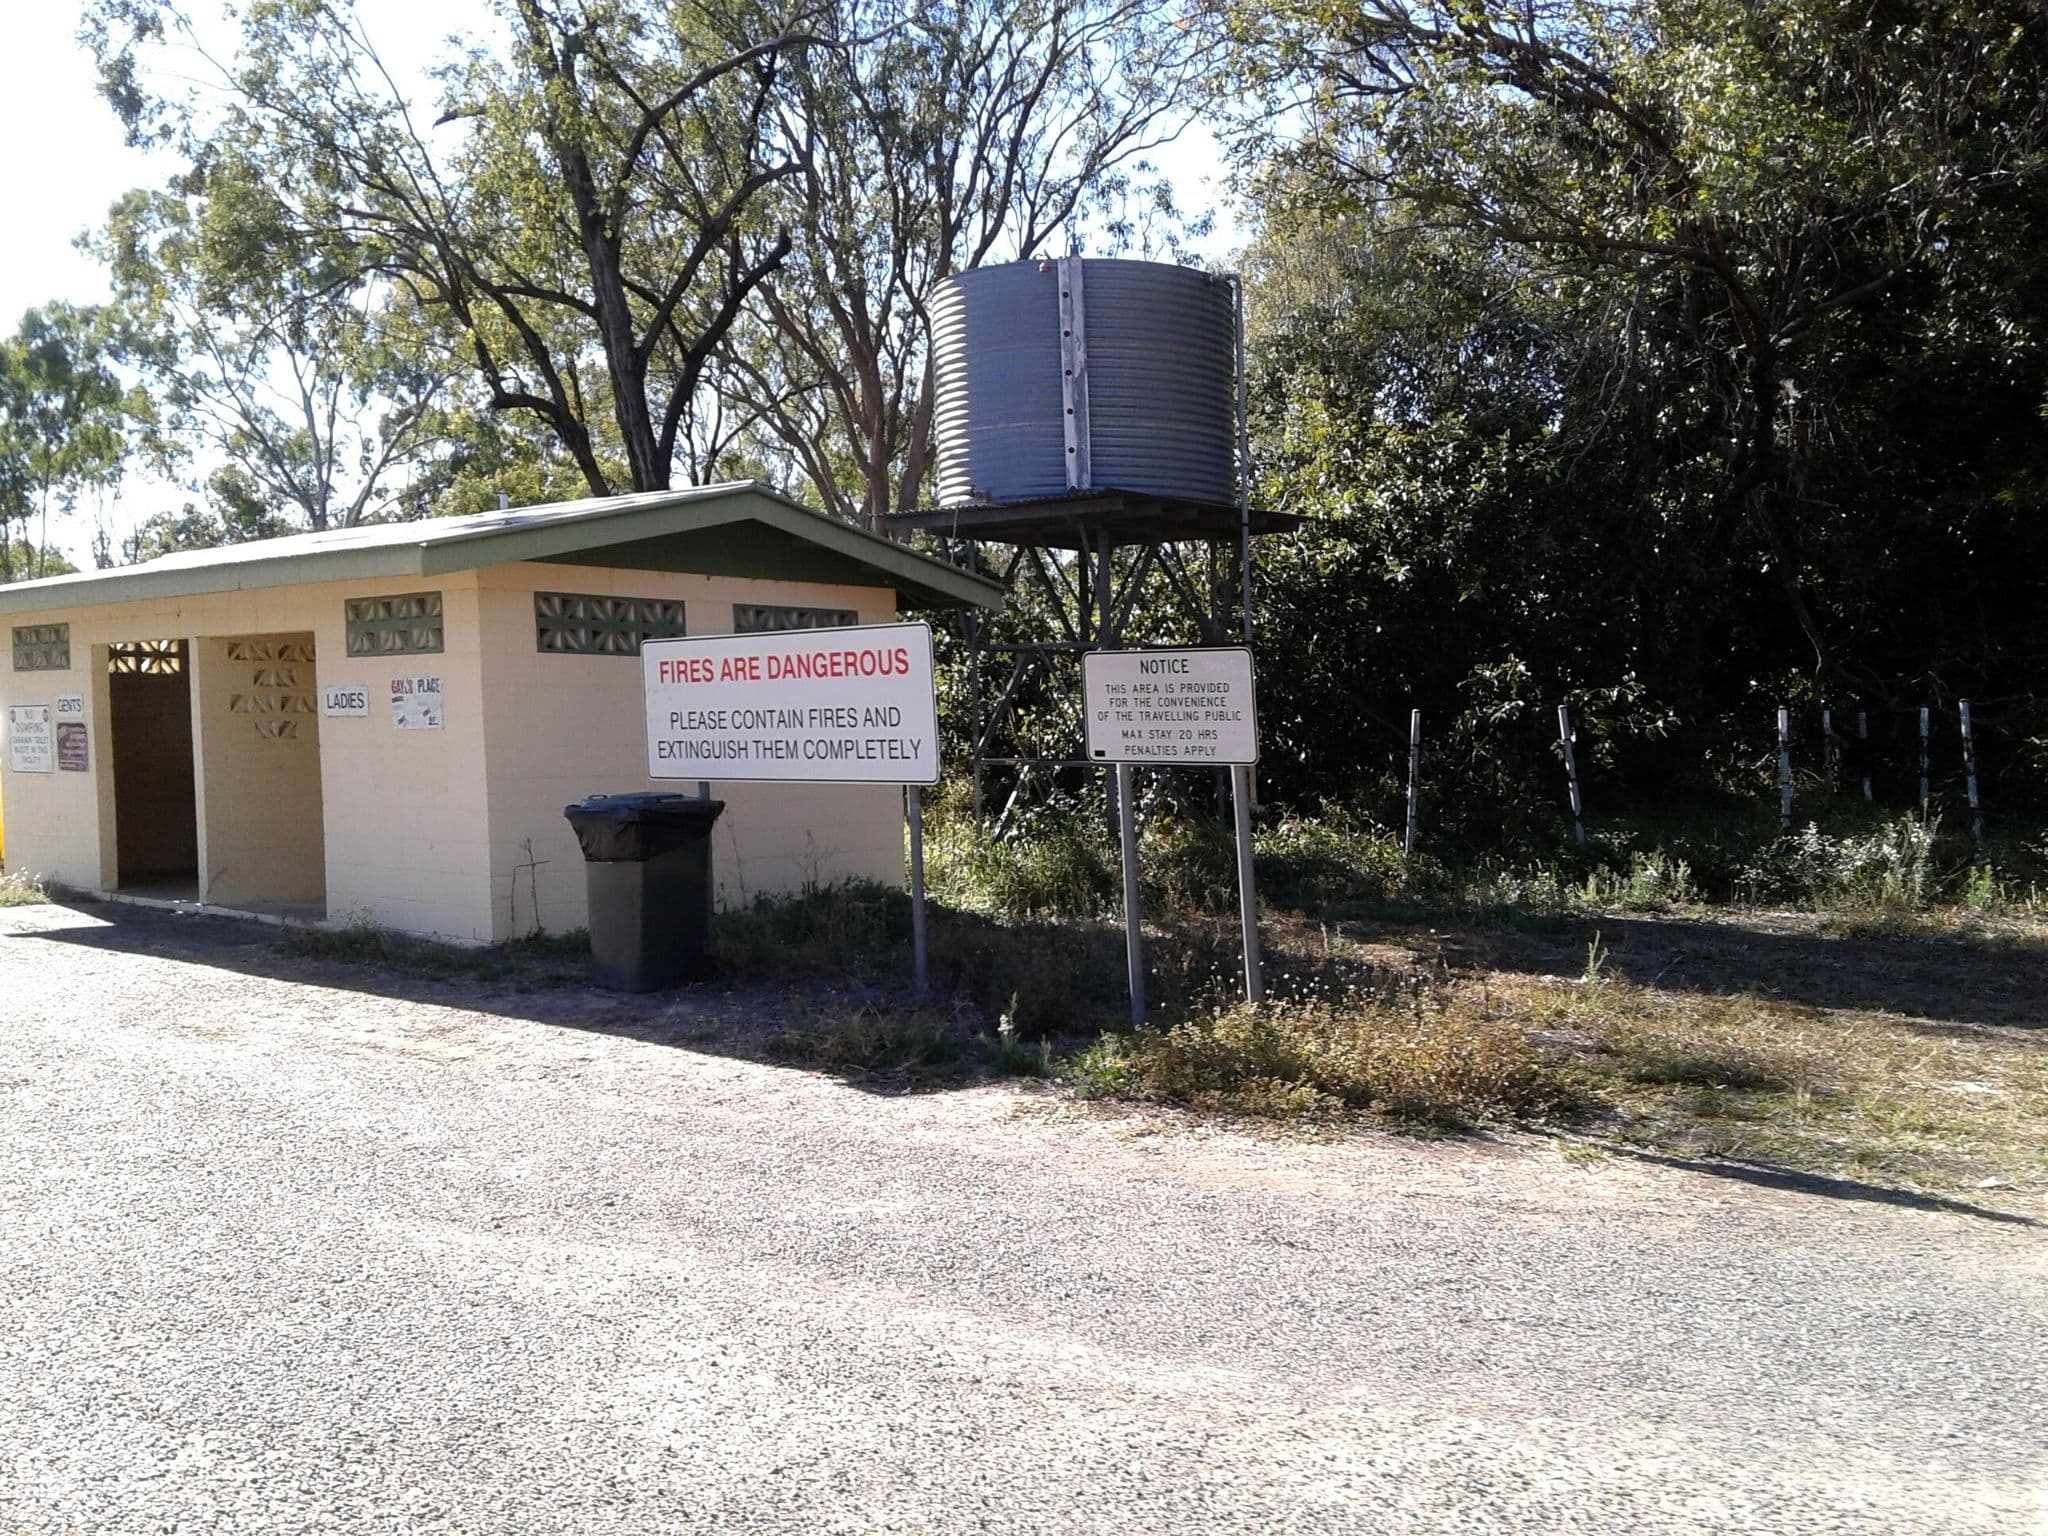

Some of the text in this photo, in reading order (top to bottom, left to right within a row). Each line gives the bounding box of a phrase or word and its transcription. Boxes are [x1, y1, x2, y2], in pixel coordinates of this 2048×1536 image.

[659, 648, 910, 683] FIRES ARE DANGEROUS
[1140, 659, 1190, 674] NOTICE
[417, 678, 441, 693] PLACE
[1105, 682, 1231, 695] THIS AREA IS PROVIDED
[57, 698, 82, 712] GENTS
[326, 692, 365, 709] LADIES
[1109, 697, 1227, 708] FOR THE CONVENIENCE
[670, 707, 901, 730] PLEASE CONTAIN FIRES AND
[1097, 711, 1241, 722] OF THE TRAVELLING PUBLIC
[1121, 729, 1218, 740] MAX STAY 20 HRS
[658, 738, 922, 760] EXTINGUISH THEM COMPLETELY
[1124, 745, 1217, 756] PENALTIES APPLY
